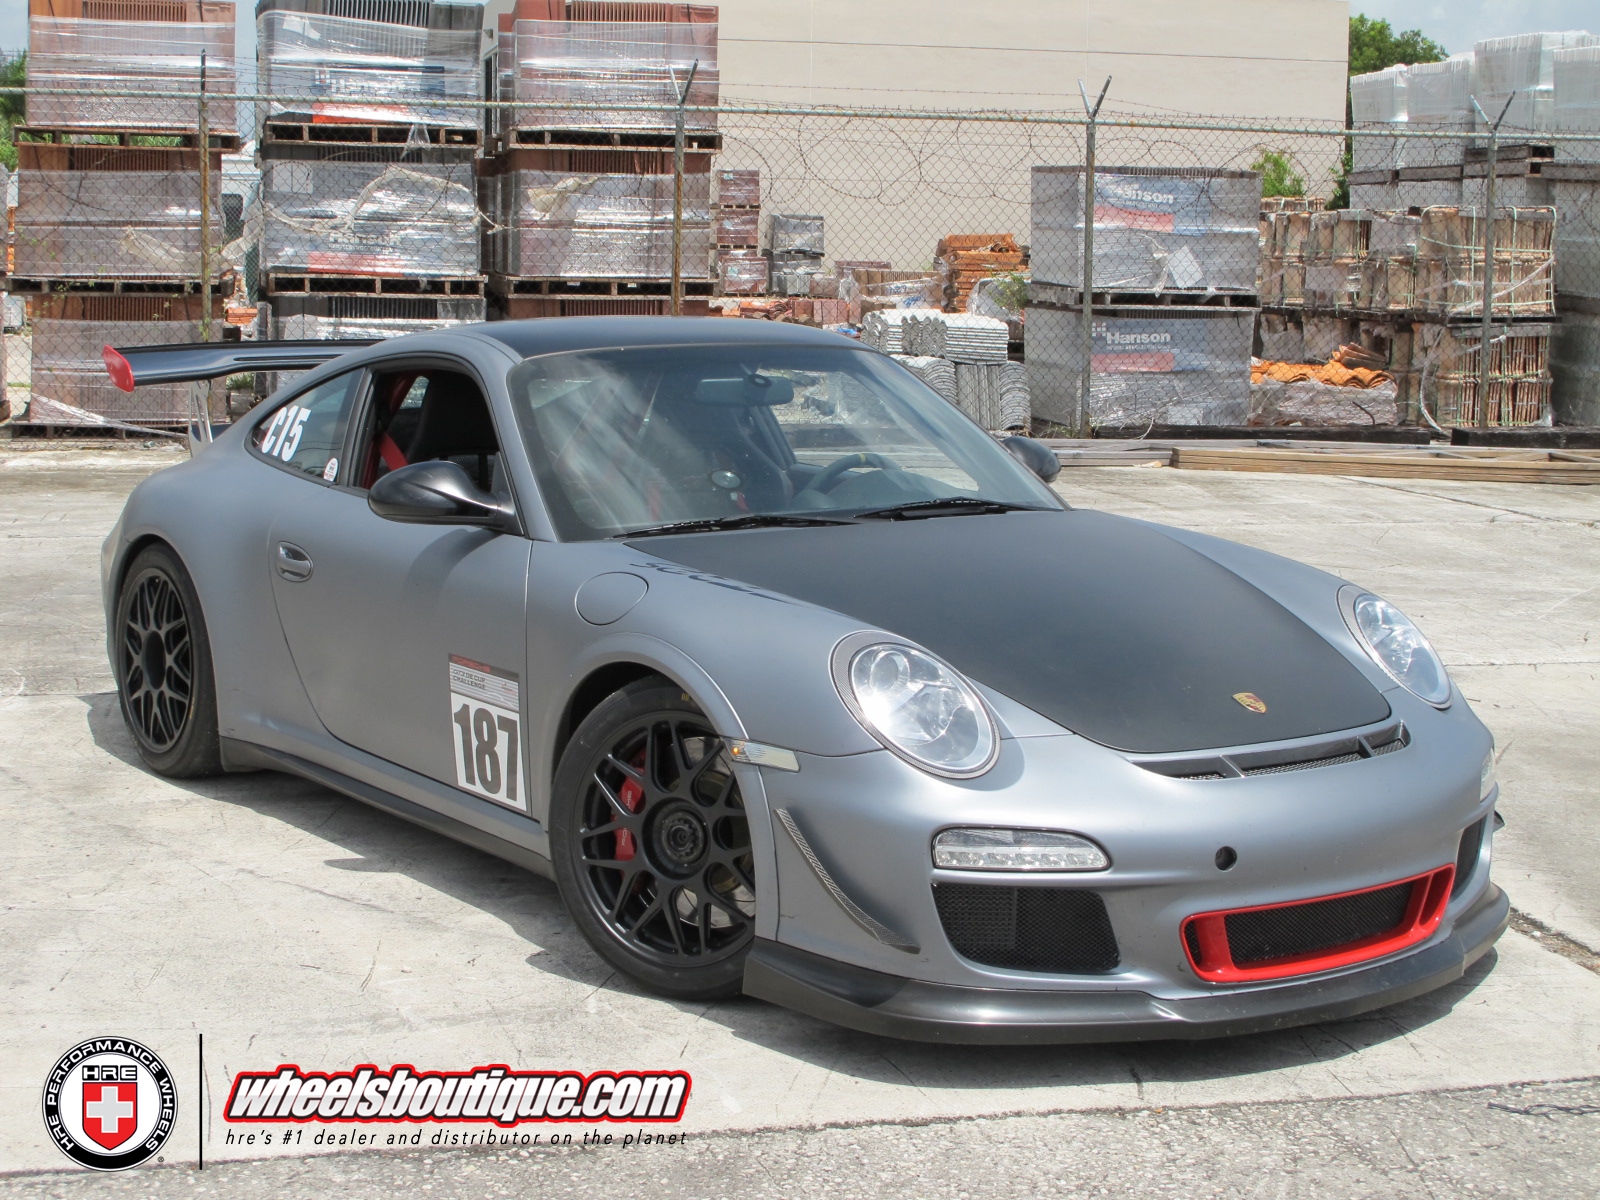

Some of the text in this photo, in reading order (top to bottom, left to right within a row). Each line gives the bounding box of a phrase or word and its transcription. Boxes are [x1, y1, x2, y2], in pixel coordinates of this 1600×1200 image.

[1106, 331, 1171, 344] Hanson
[261, 405, 312, 462] C15
[454, 703, 518, 801] 187
